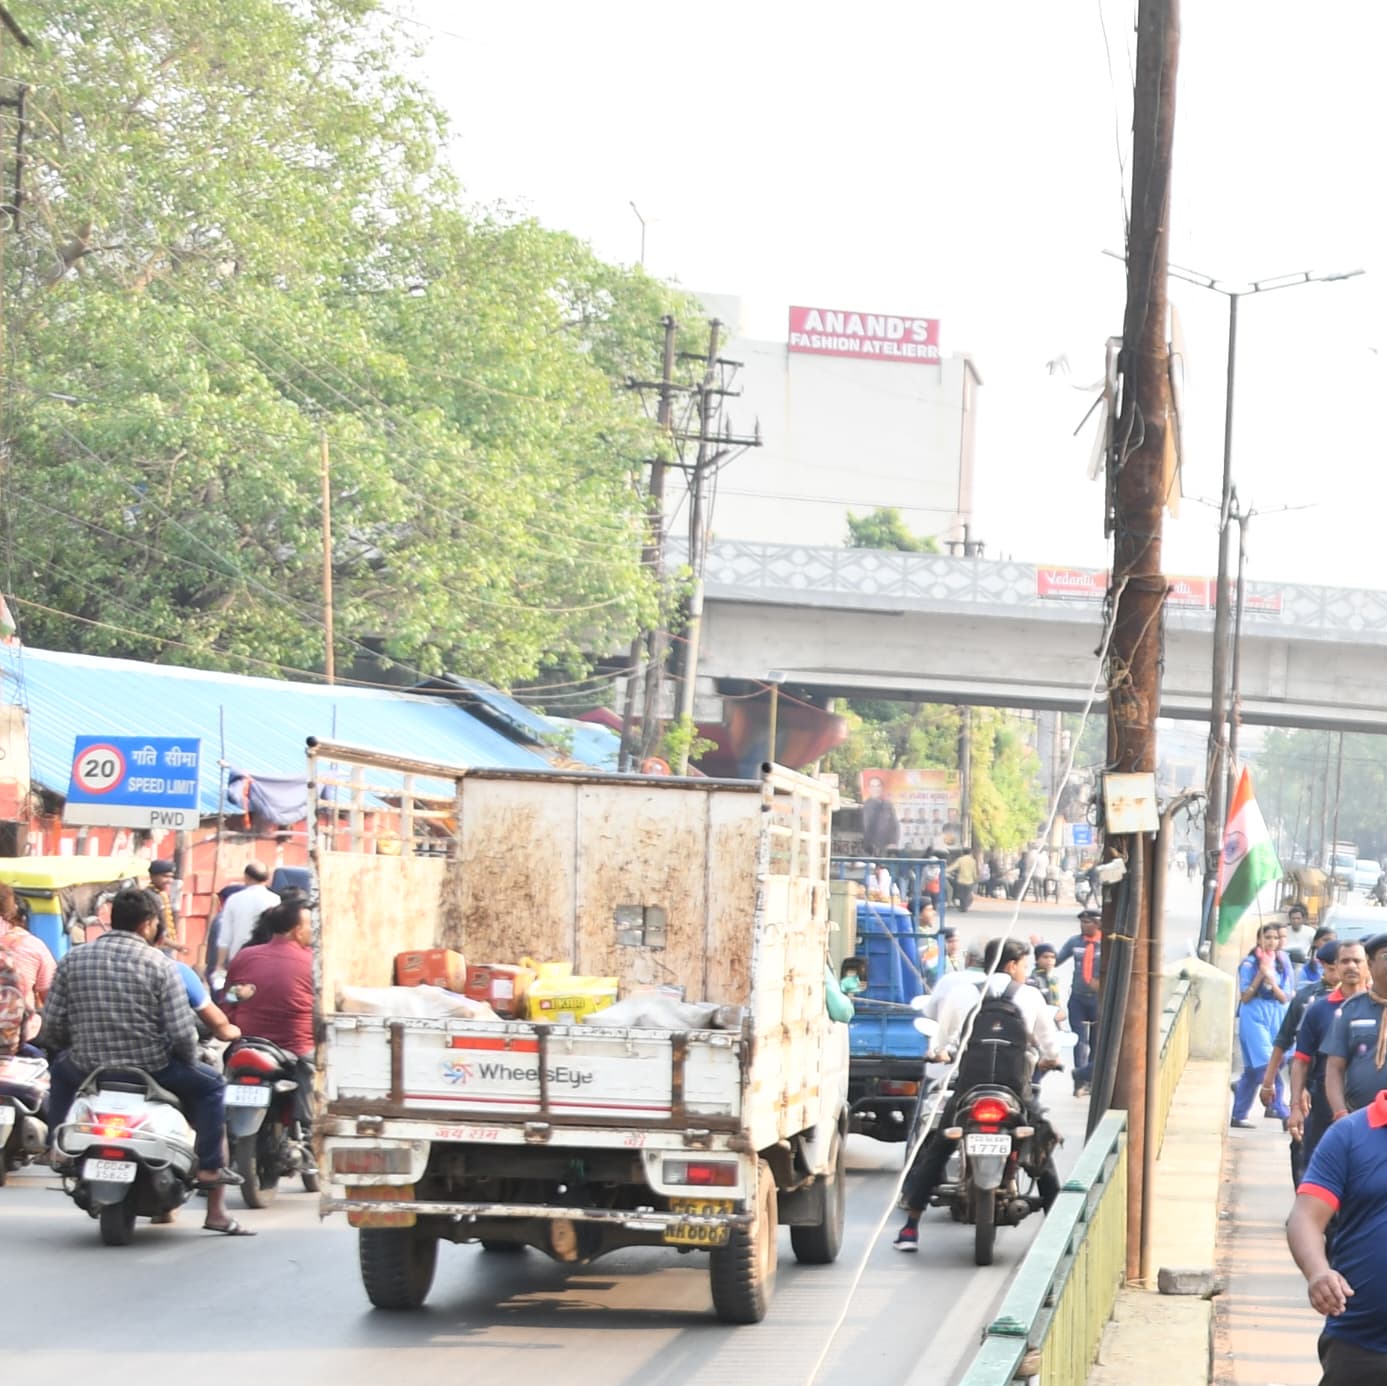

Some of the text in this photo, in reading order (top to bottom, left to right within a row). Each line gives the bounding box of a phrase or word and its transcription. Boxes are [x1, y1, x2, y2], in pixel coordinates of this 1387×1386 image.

[804, 309, 929, 342] ANAND'S
[790, 332, 861, 353] FASHION
[1045, 570, 1097, 587] Vedantu
[131, 745, 198, 768] गति सीमा
[83, 759, 116, 778] 20
[127, 776, 197, 795] SPEED LIMIT
[150, 810, 185, 827] PWD
